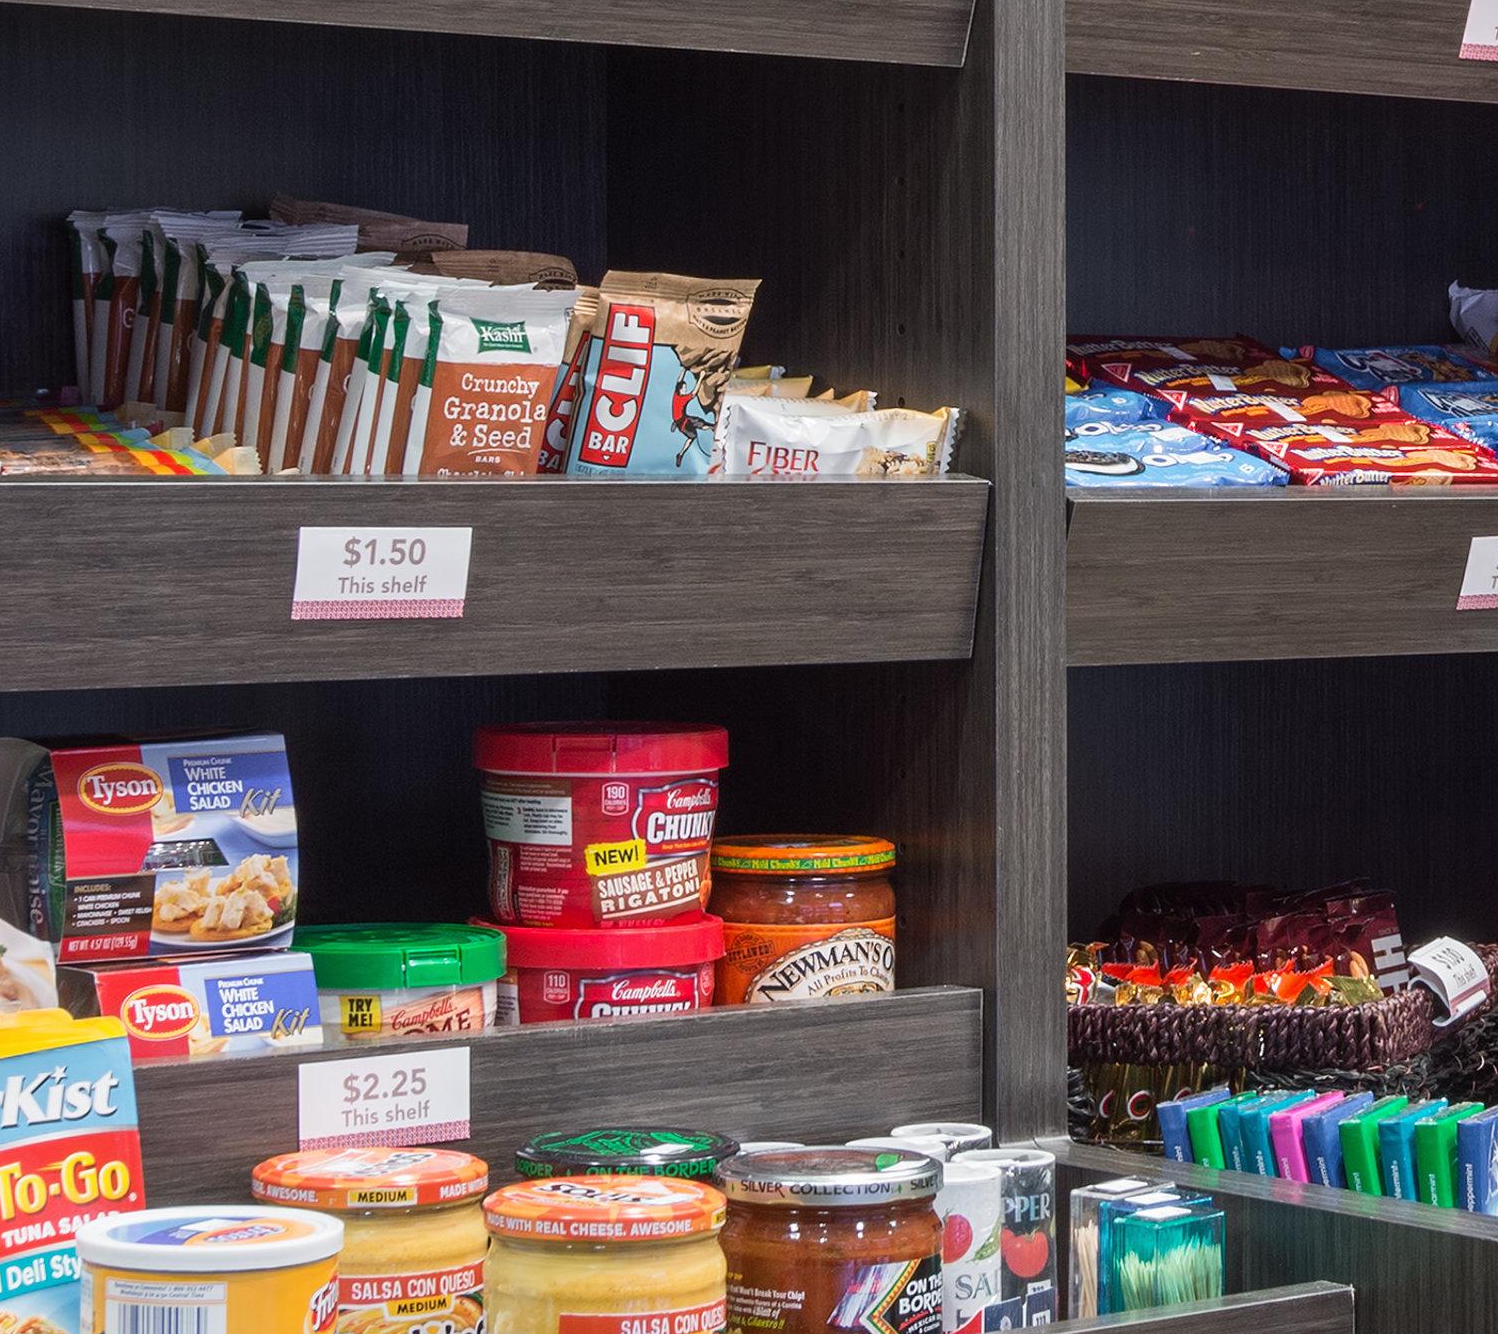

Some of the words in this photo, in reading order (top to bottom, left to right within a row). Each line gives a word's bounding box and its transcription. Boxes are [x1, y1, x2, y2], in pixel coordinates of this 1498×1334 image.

[481, 324, 526, 344] Kashi
[602, 308, 655, 432] CLIF
[461, 373, 540, 399] Crunchy
[443, 397, 547, 424] Granola
[588, 432, 629, 455] BAR
[475, 455, 500, 464] BARS
[747, 440, 819, 472] FIBER
[342, 536, 427, 568] $1.50
[338, 576, 375, 595] This
[381, 575, 427, 595] shelf
[184, 767, 226, 781] WHITE
[86, 773, 157, 804] Tyson
[187, 779, 244, 796] CHICKEN
[605, 786, 625, 800] 190
[189, 795, 231, 811] SALAD
[593, 848, 640, 867] NEW!
[597, 871, 652, 899] SAUSAGE
[655, 870, 665, 887] &
[664, 858, 698, 886] PEPPER
[600, 877, 700, 913] RIGATONI
[757, 940, 882, 1002] NEWMAN'S
[807, 978, 822, 996] All
[823, 968, 857, 986] Profits
[858, 966, 869, 976] To
[219, 988, 260, 1003] WHITE
[347, 997, 373, 1013] TRY
[129, 999, 196, 1027] Tyson
[221, 1000, 275, 1019] CHICKEN
[348, 1011, 374, 1028] ME!
[223, 1015, 264, 1034] SALAD
[341, 1068, 428, 1105] $2.25
[340, 1107, 381, 1127] This
[384, 1100, 431, 1125] shelf
[357, 1190, 409, 1205] MEDIUM
[740, 1179, 785, 1198] SILVER
[788, 1180, 892, 1198] COLLECTION
[1, 1219, 55, 1250] TUNA
[351, 1279, 398, 1301] SALSA
[400, 1276, 425, 1296] CON
[429, 1268, 477, 1295] QUESO
[395, 1295, 449, 1316] MEDIUM
[670, 1309, 699, 1333] CON
